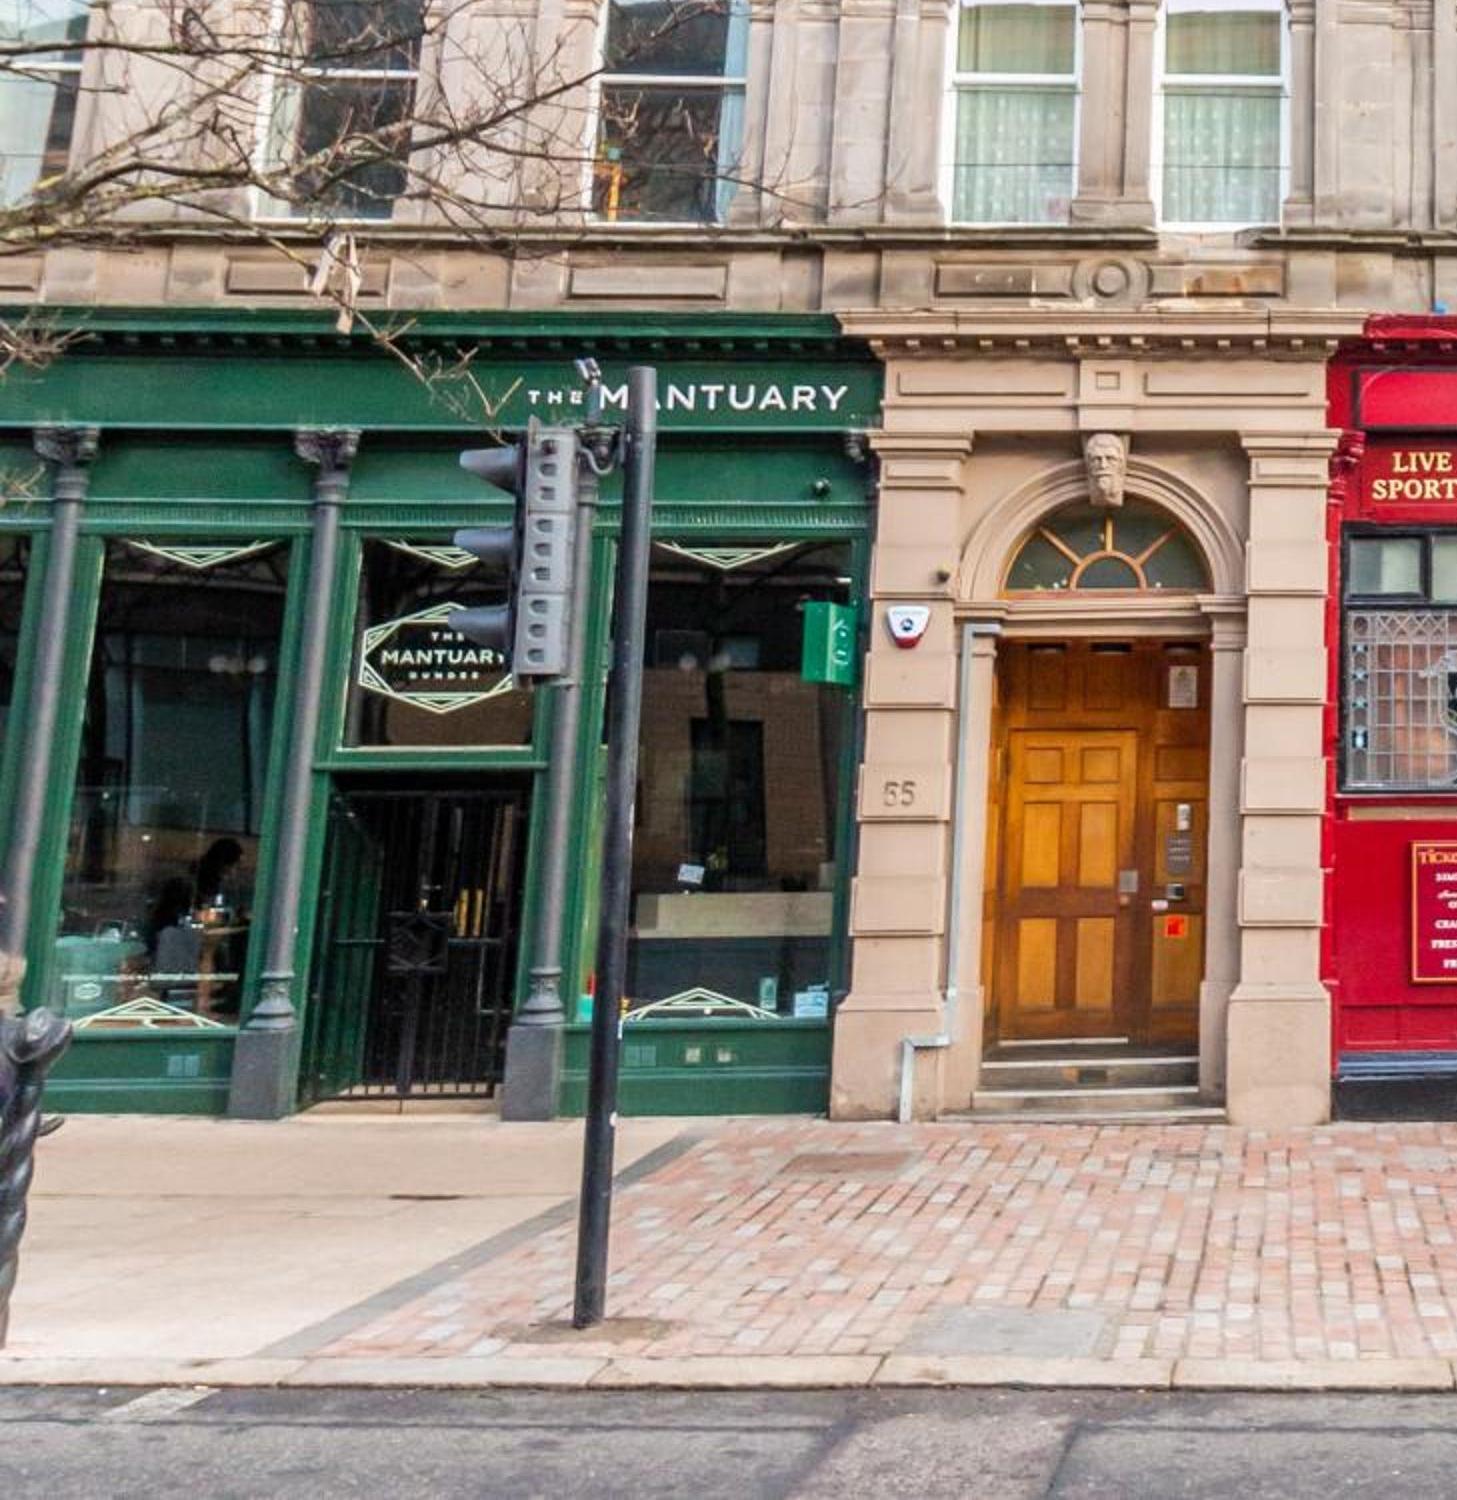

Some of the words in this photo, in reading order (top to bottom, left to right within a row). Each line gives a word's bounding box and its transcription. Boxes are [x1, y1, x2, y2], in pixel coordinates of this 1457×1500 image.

[527, 389, 584, 405] THE
[599, 384, 849, 411] MNTUARY
[1391, 451, 1453, 473] LIVE
[430, 631, 466, 642] THE
[883, 780, 917, 807] 55
